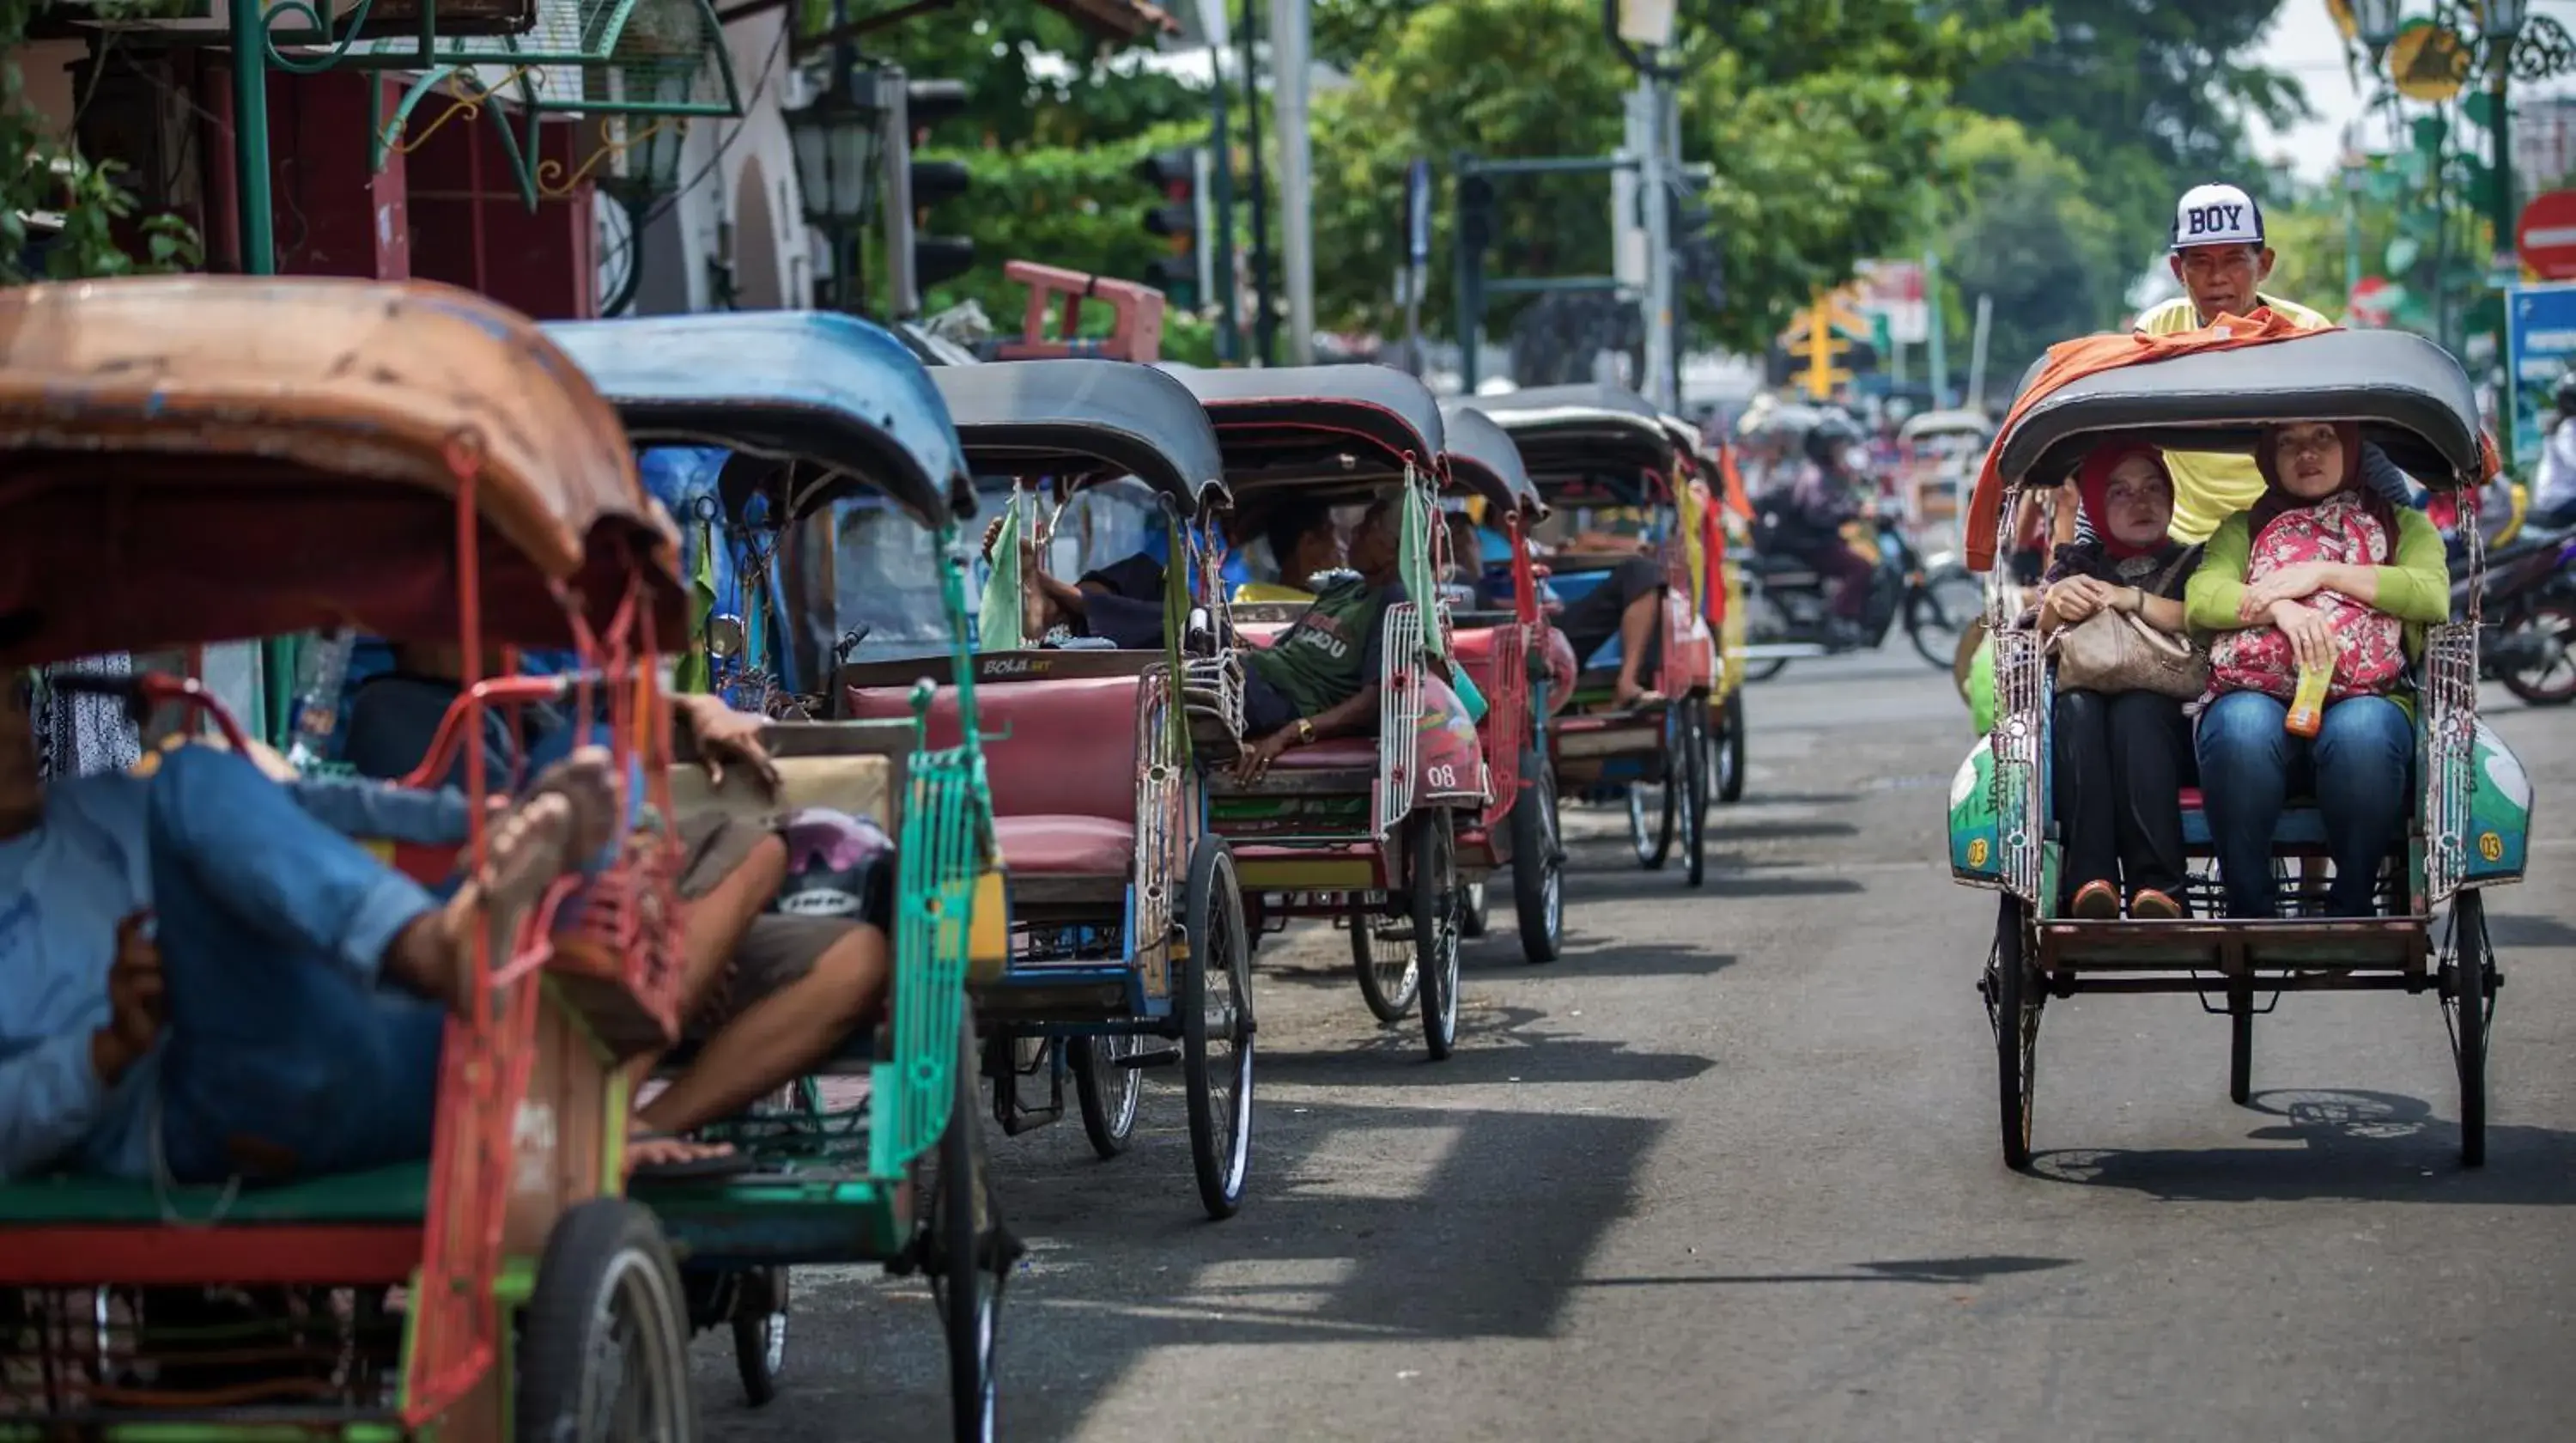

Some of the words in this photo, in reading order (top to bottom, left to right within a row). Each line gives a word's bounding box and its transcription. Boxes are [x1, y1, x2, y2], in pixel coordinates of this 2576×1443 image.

[2187, 204, 2244, 235] BOY
[1427, 764, 1456, 788] 08
[1970, 841, 1985, 863] 03
[2482, 836, 2500, 859] 03
